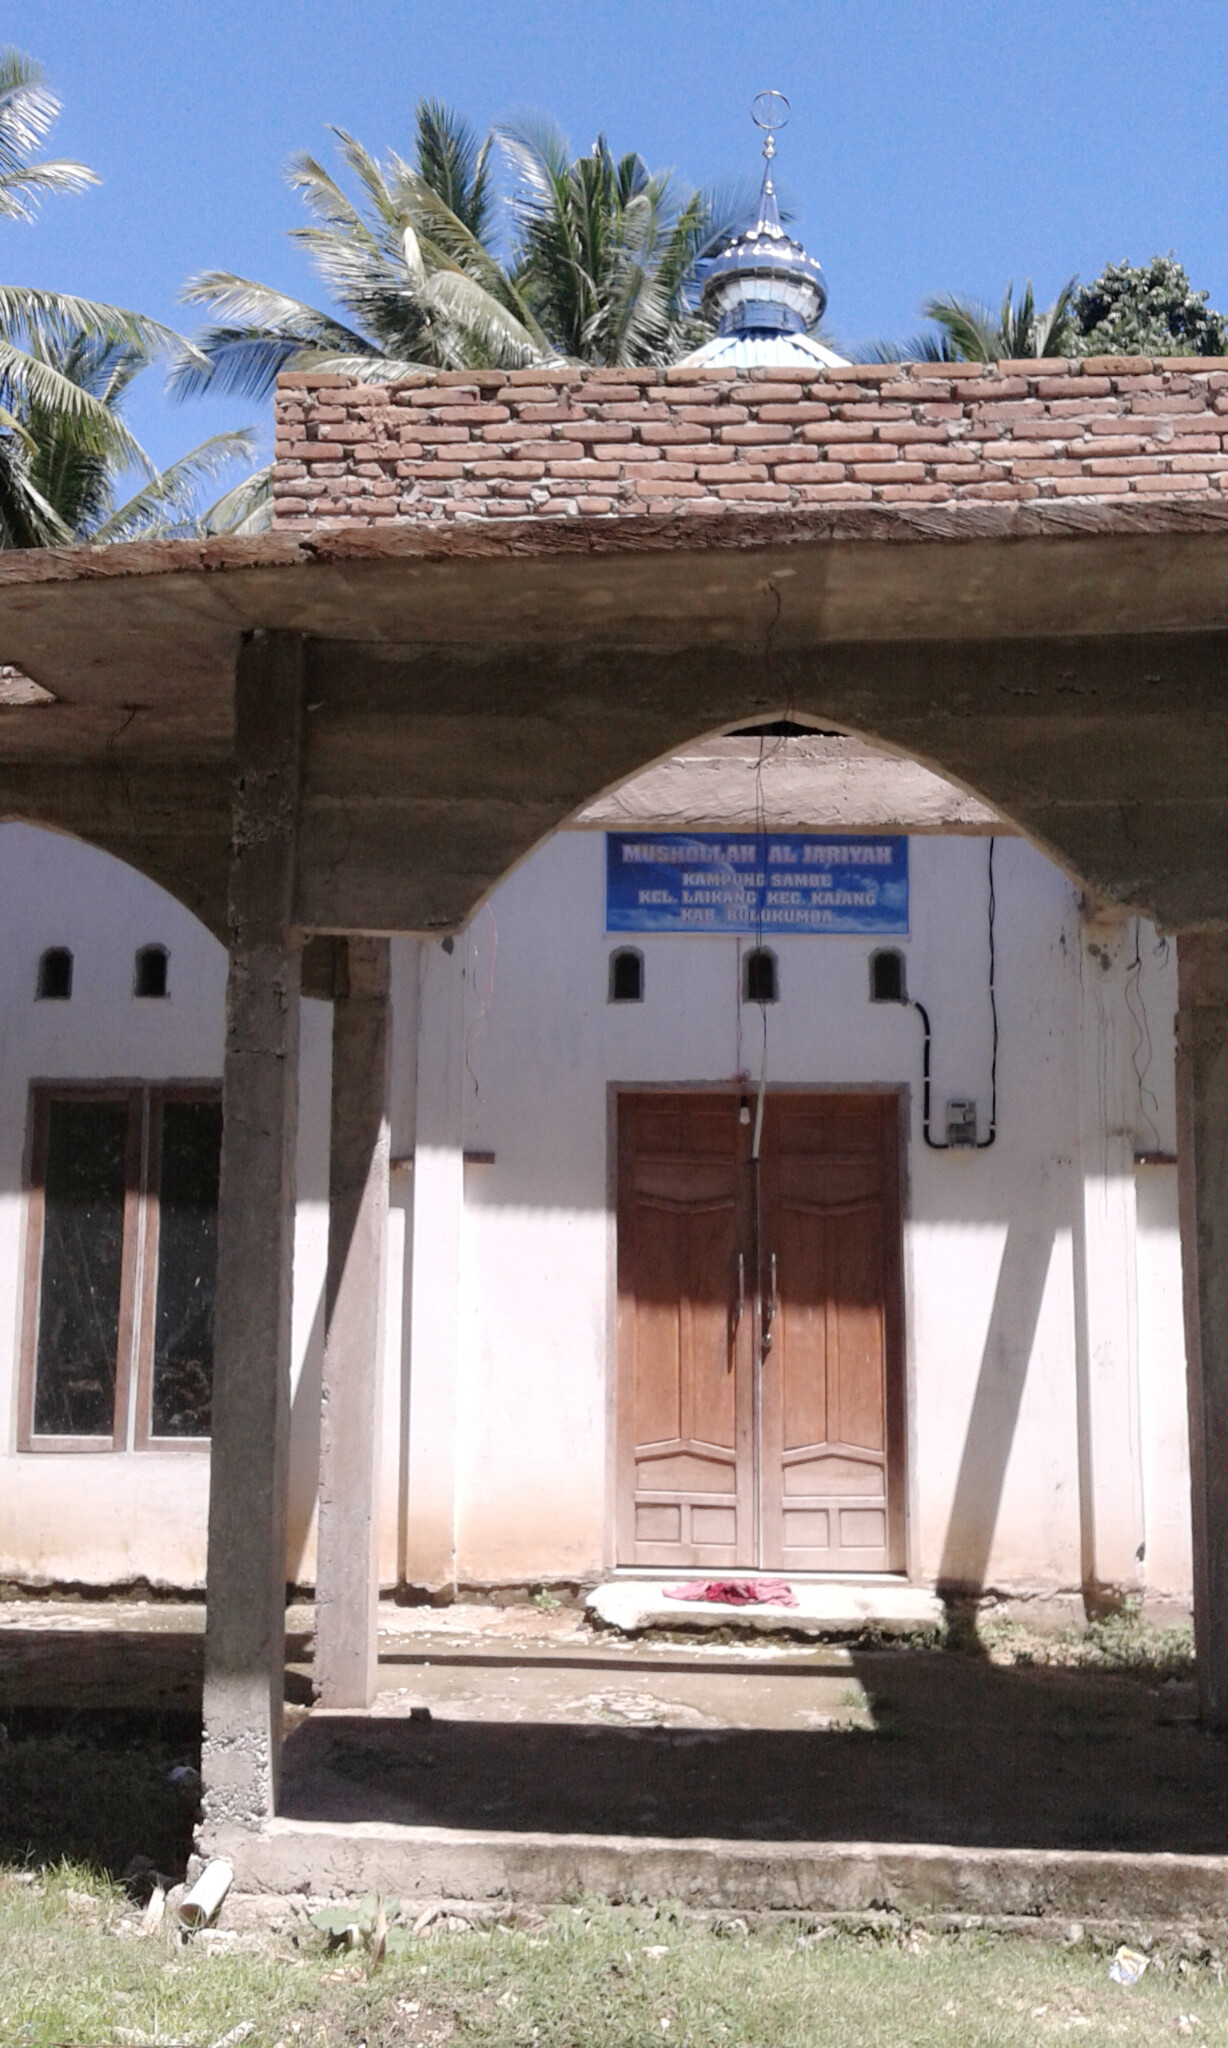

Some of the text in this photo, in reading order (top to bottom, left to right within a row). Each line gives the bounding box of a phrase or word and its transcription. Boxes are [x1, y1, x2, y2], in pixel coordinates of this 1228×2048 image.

[622, 844, 893, 864] MUSHOLLAH AL JARIYAH
[682, 873, 832, 887] KAMPUNG SAMBE
[682, 890, 757, 904] LAIKANG
[810, 891, 876, 906] KAJANG
